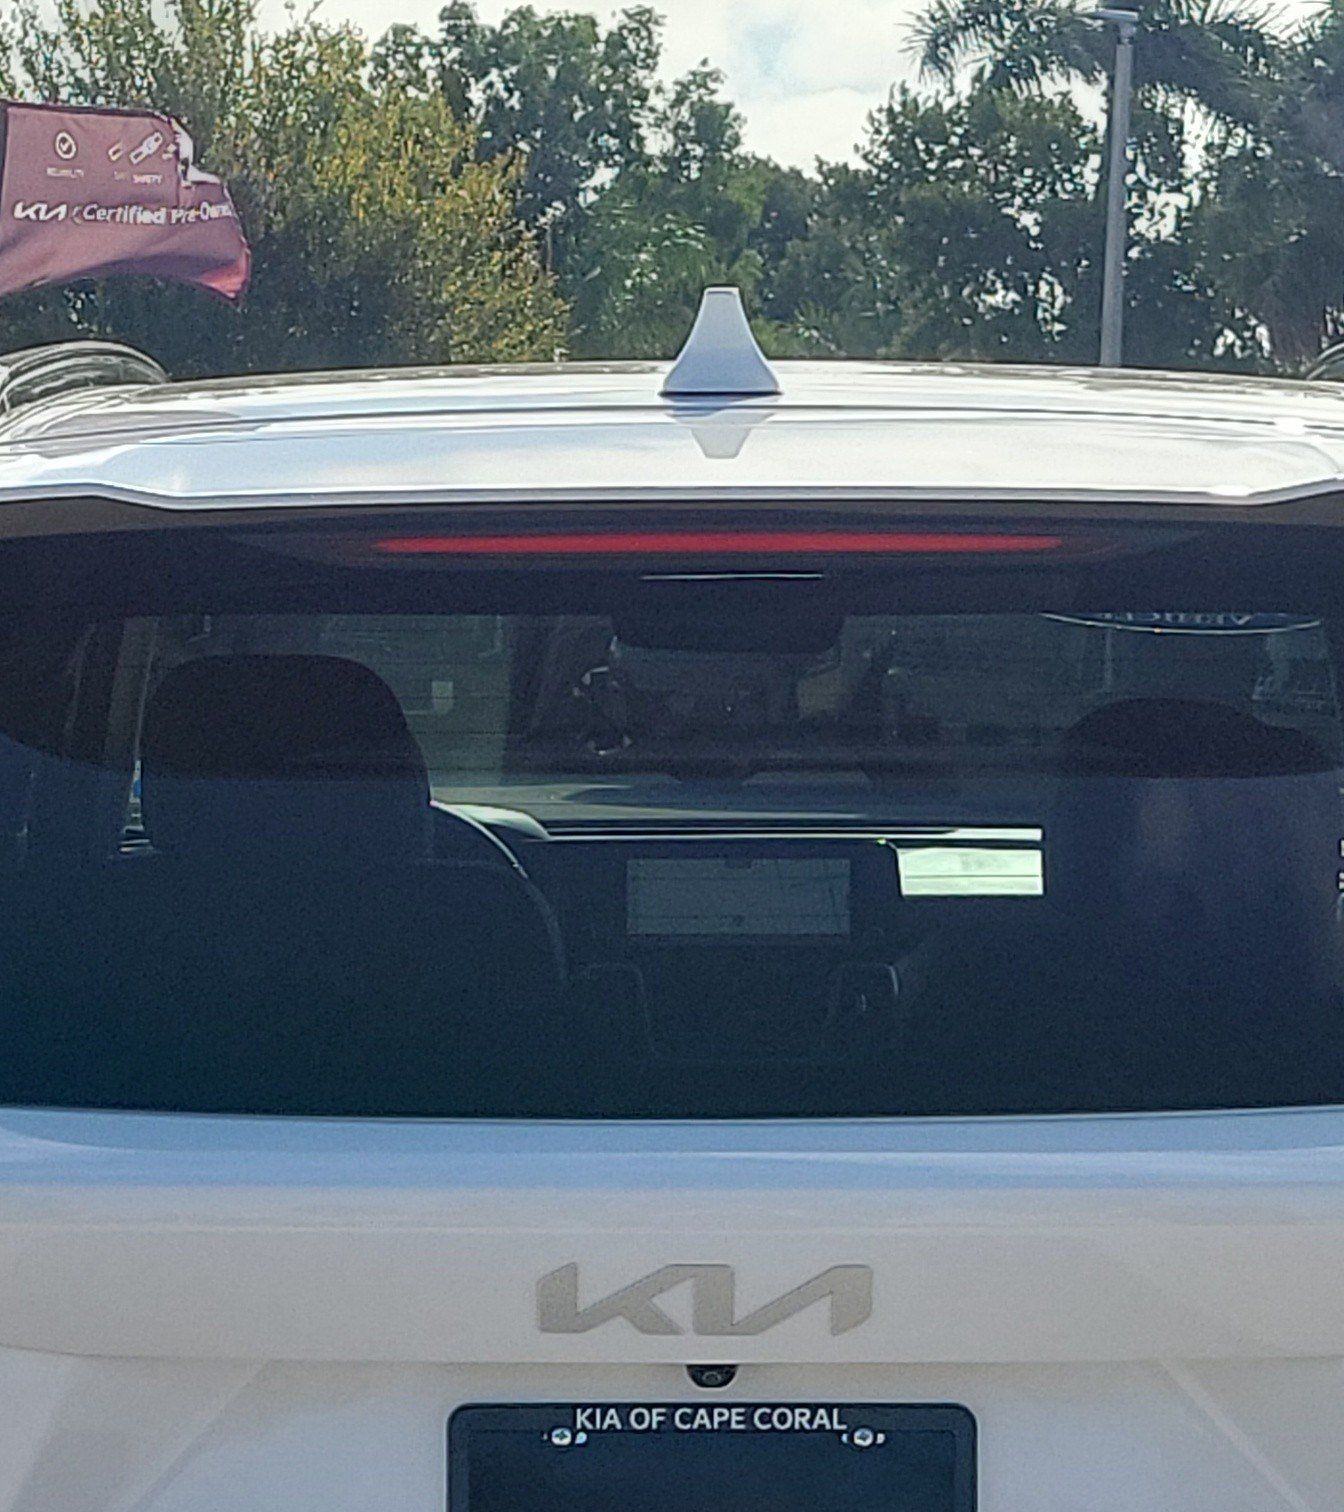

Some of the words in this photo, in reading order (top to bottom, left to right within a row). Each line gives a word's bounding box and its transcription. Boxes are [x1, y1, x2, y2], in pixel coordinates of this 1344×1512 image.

[83, 202, 167, 225] Certified
[535, 1262, 874, 1336] KIA
[577, 1408, 622, 1430] KIA
[629, 1408, 666, 1430] OF
[674, 1408, 746, 1430] CAPE
[753, 1407, 847, 1431] CORAL
